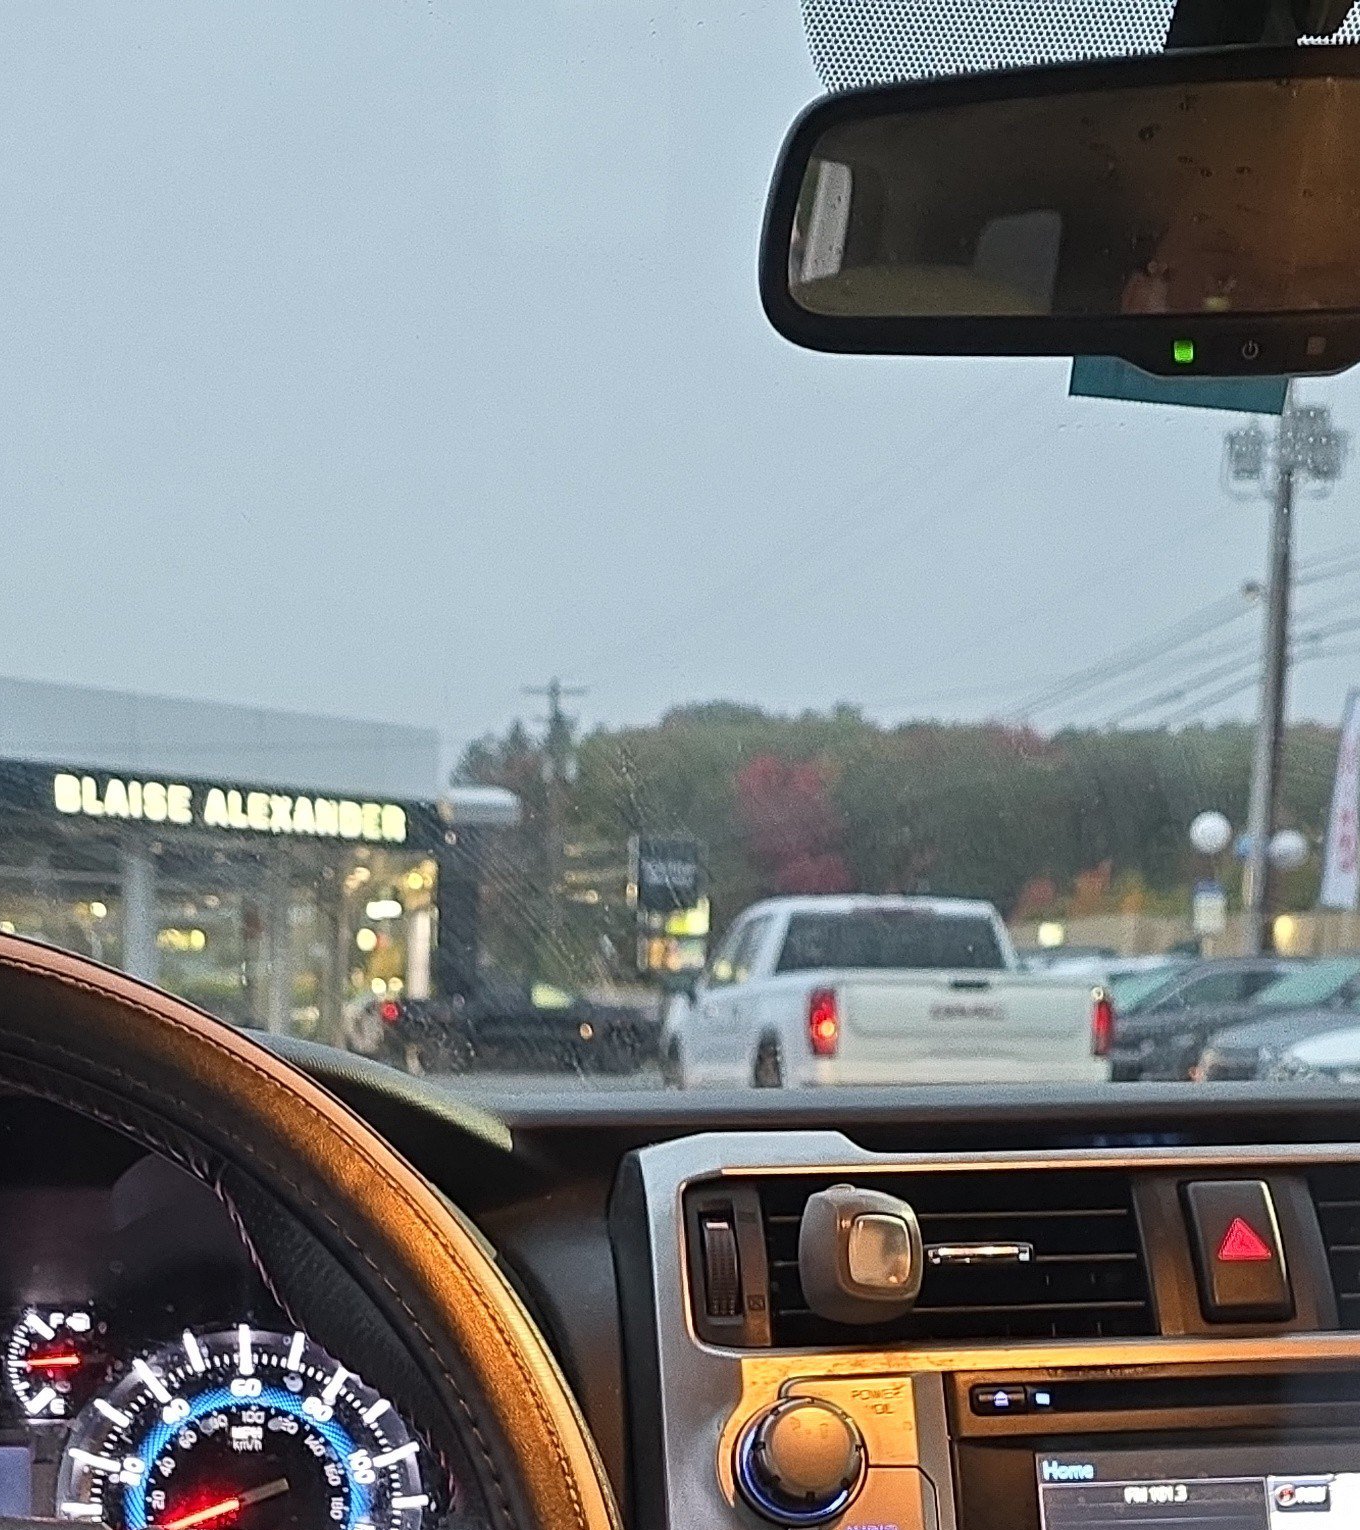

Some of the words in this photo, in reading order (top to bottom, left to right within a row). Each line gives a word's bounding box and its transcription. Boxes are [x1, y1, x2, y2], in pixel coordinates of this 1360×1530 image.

[53, 771, 193, 824] BLAISE
[203, 787, 407, 843] ALEXANDER
[230, 1378, 262, 1397] 60
[349, 1449, 377, 1485] 100
[1042, 1459, 1095, 1481] Home
[150, 1489, 166, 1511] 20
